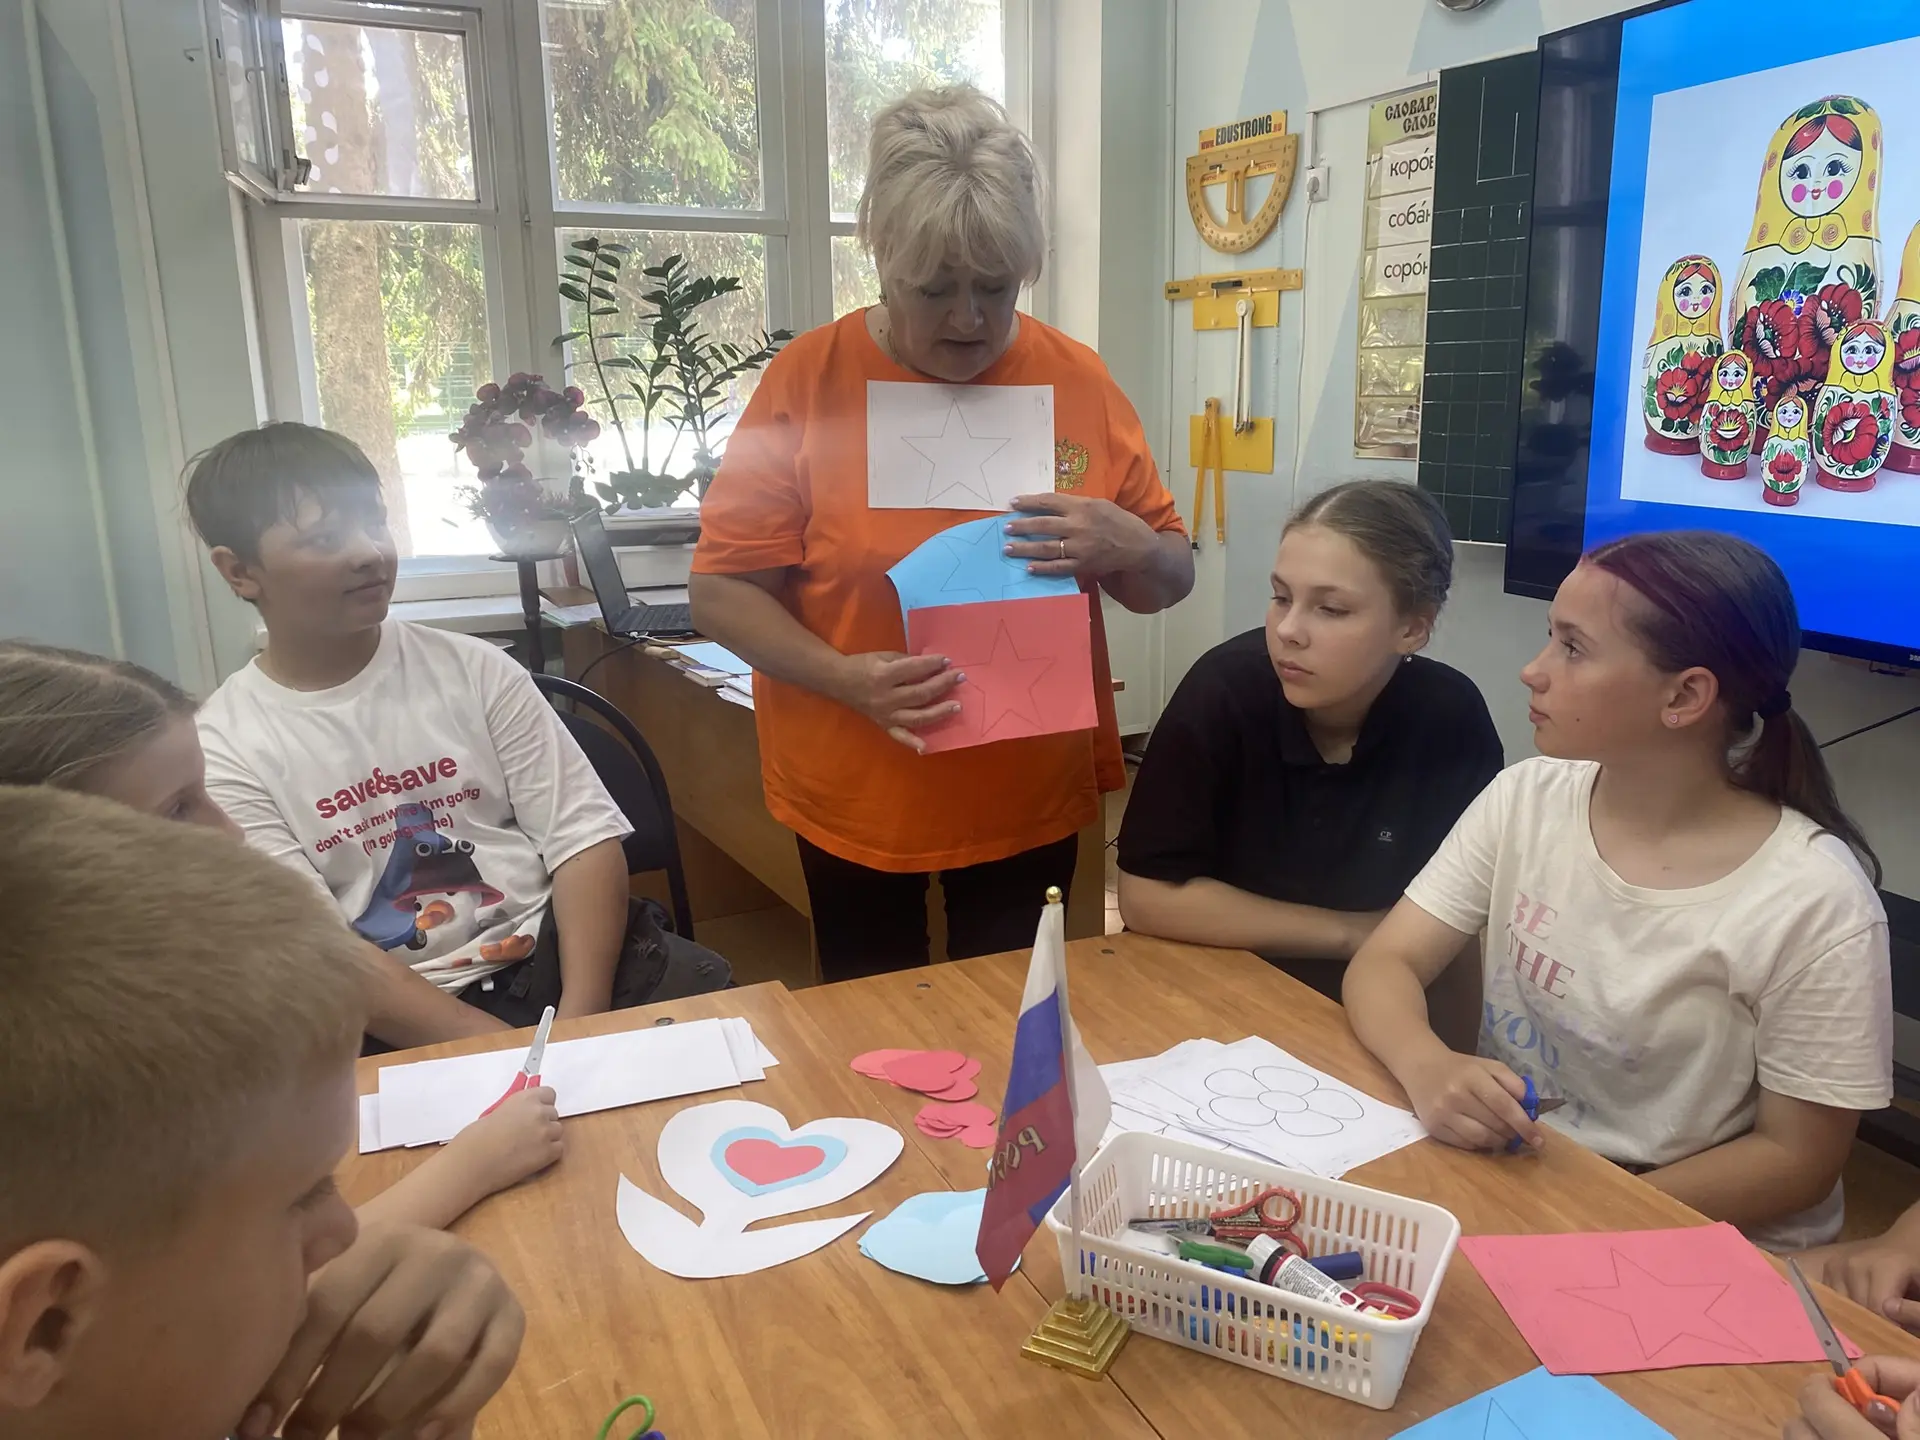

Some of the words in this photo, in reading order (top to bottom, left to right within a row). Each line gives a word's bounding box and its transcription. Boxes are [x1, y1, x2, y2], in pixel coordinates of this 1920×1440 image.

[1385, 94, 1437, 121] СЛОВАР
[1215, 114, 1272, 146] EDUSTRONG
[316, 757, 457, 819] save&save
[316, 828, 354, 853] don't
